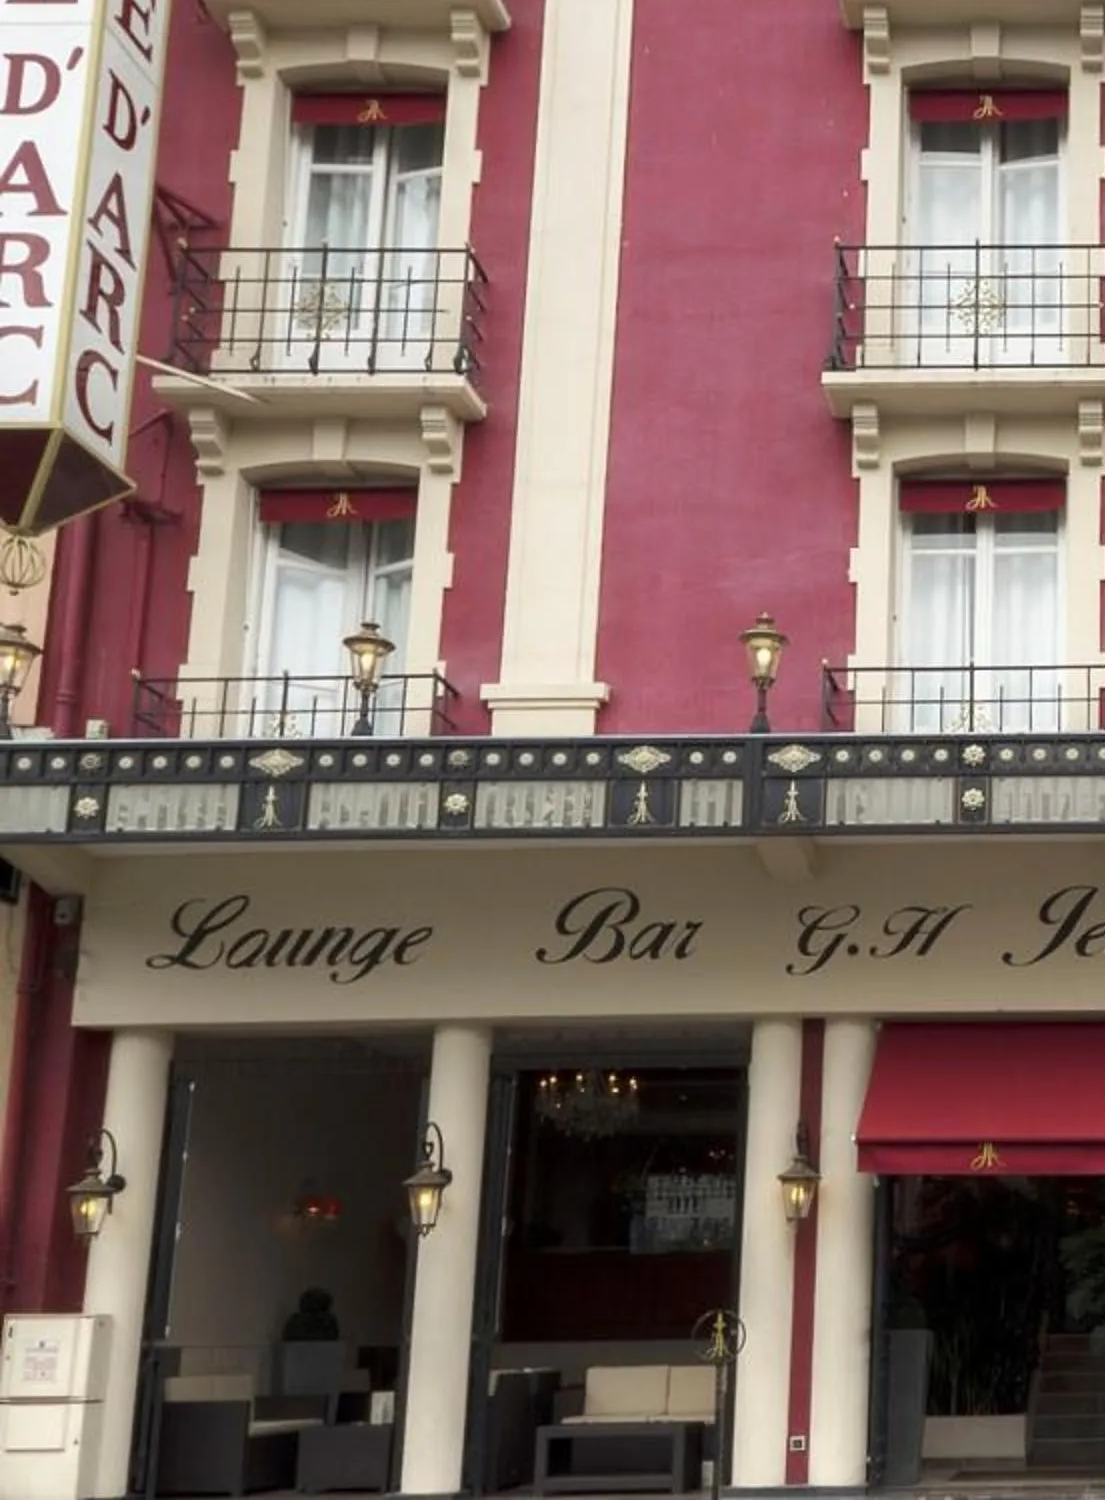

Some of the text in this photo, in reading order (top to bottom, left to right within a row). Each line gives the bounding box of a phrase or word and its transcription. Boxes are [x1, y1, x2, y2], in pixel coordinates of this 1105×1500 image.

[75, 68, 151, 446] D'ARC
[145, 886, 705, 984] Lounge Bar
[785, 902, 974, 976] G.H
